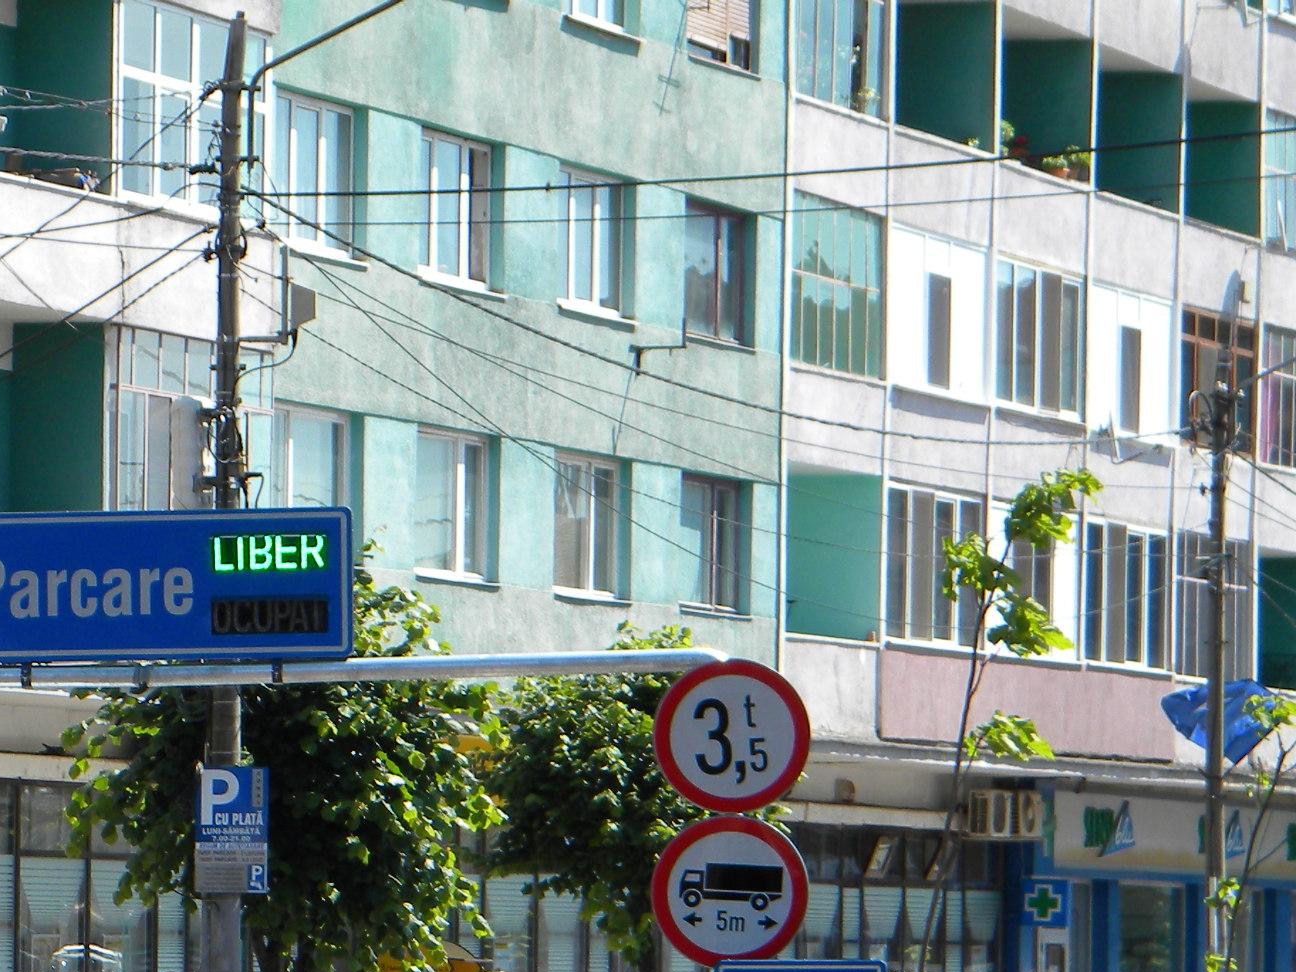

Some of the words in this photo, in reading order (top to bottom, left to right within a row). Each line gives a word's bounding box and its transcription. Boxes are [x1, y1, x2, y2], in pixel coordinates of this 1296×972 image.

[213, 534, 326, 572] LIBER
[201, 769, 239, 825] P
[715, 911, 745, 933] 5m
